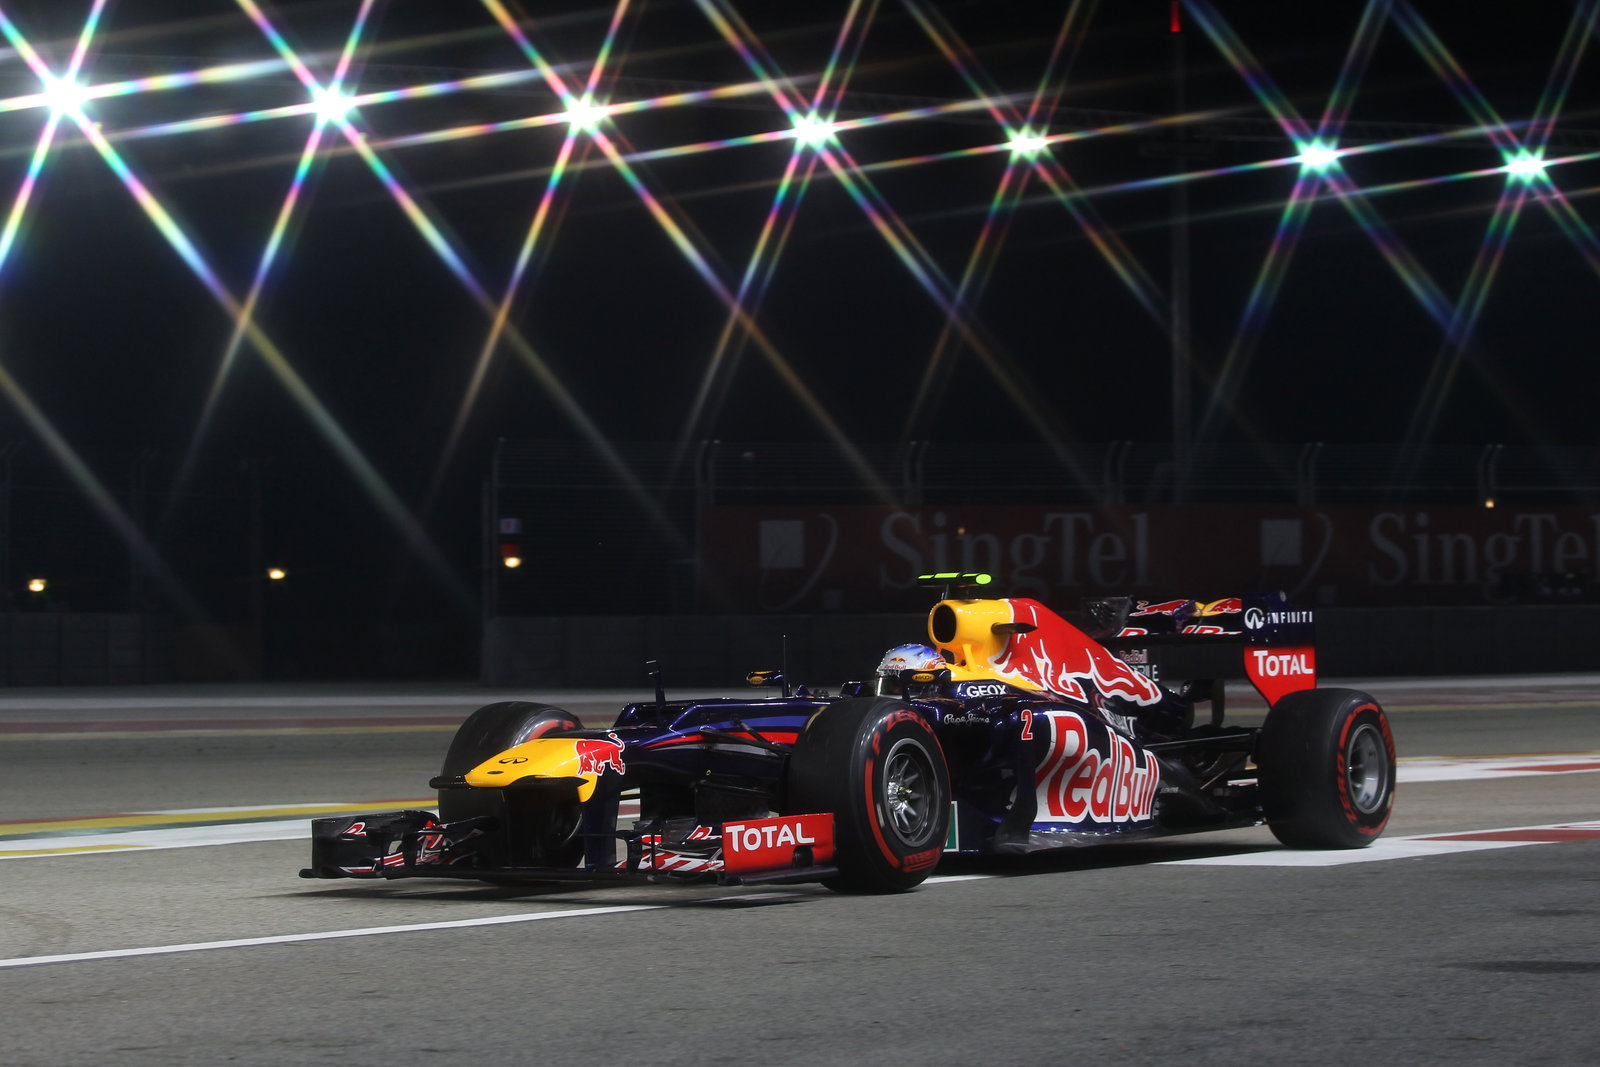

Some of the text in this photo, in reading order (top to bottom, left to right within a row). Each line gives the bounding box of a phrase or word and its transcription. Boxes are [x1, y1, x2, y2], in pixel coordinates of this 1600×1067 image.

[878, 511, 1153, 601] SingTel
[1266, 611, 1313, 624] INFINITI
[1253, 650, 1314, 677] TOTAL
[966, 684, 1008, 698] GEOX
[885, 709, 933, 735] ZERO
[943, 713, 967, 725] Pepe
[1020, 709, 1033, 741] 2
[1034, 710, 1159, 823] Red Bull
[725, 823, 815, 852] TOTAL
